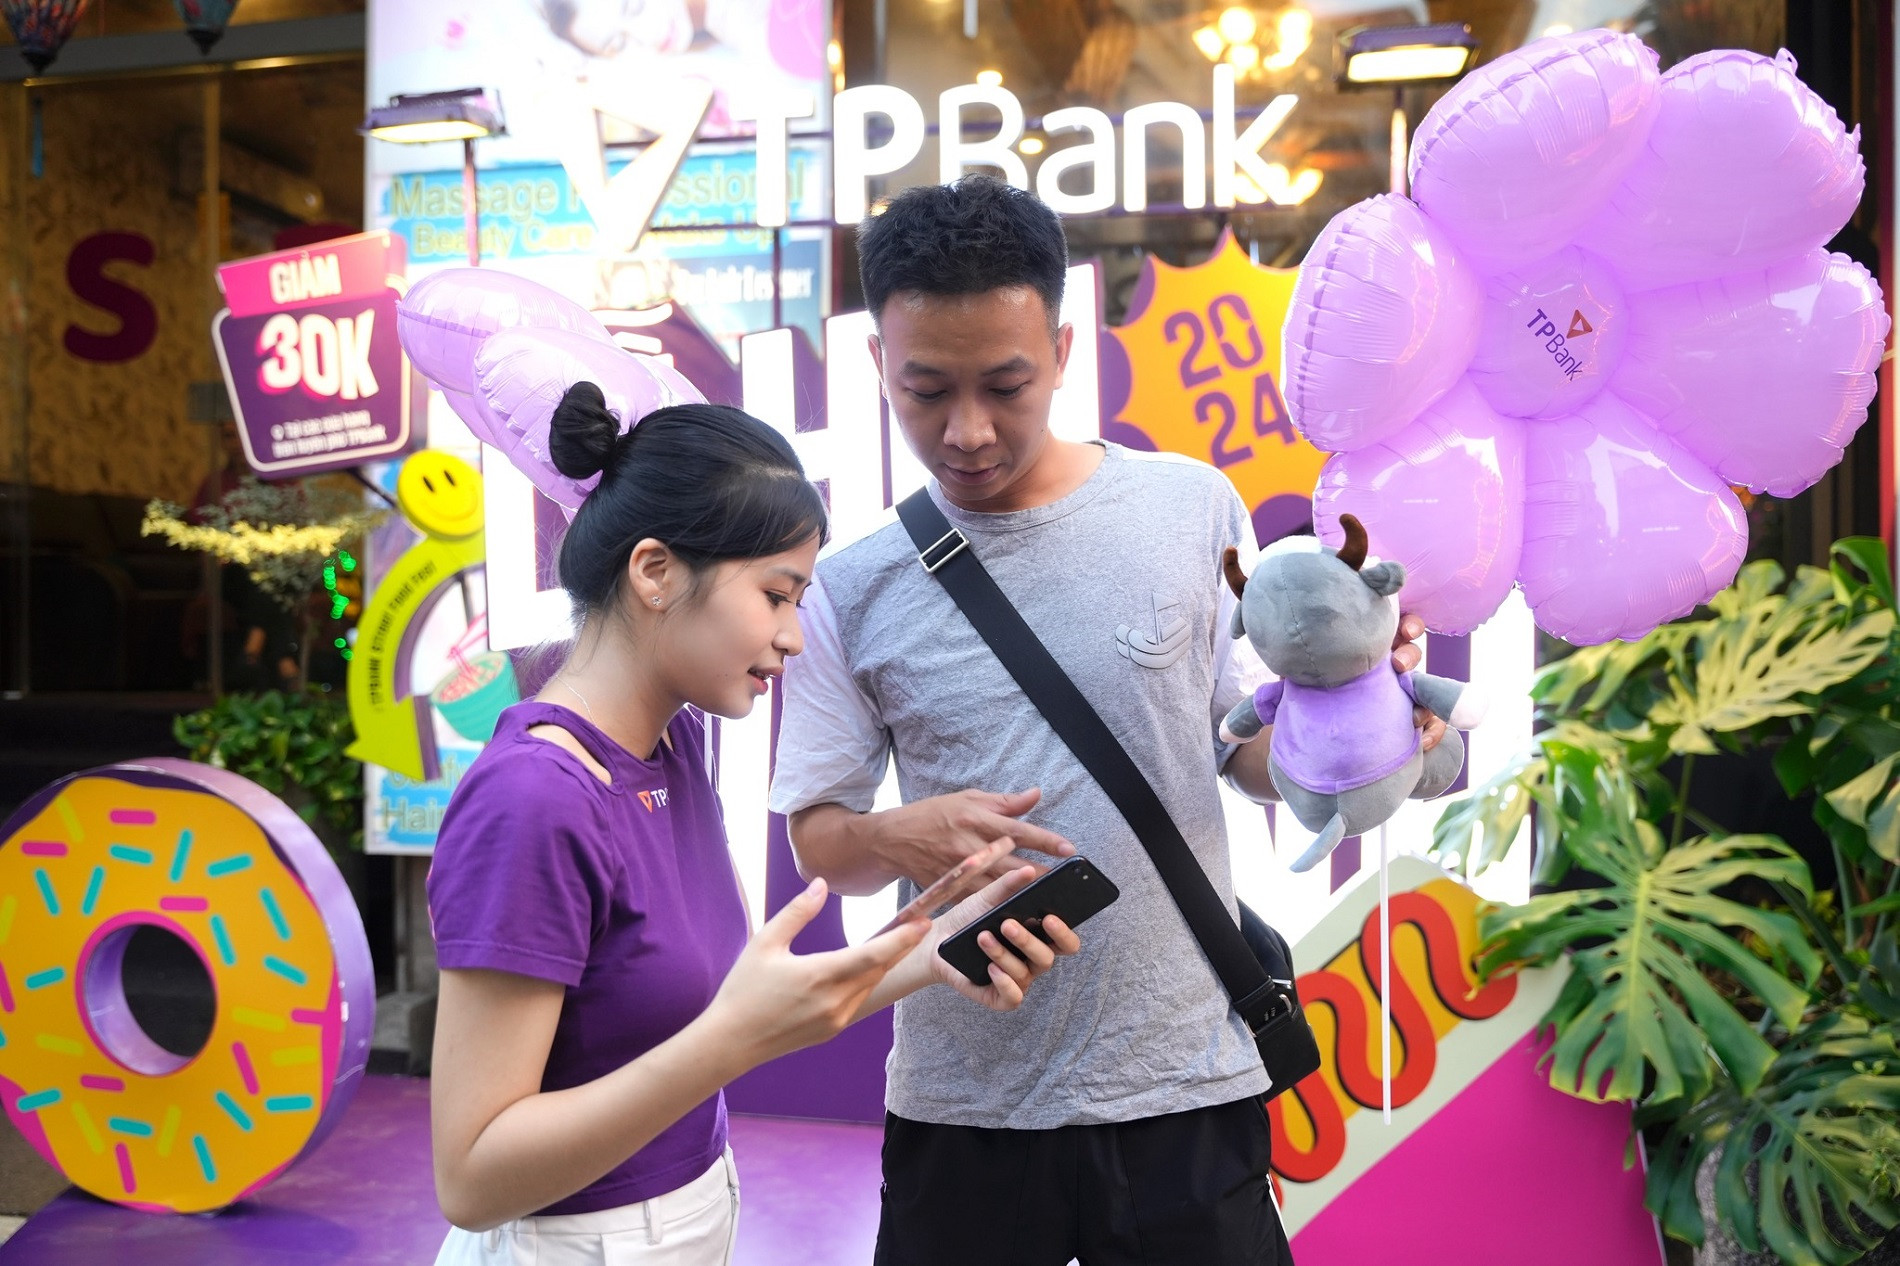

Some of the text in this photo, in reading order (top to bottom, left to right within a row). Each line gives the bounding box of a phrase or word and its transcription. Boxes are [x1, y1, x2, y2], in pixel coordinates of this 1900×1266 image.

[729, 63, 1299, 227] TPBank
[269, 250, 343, 304] GIẢM
[414, 223, 515, 257] Beaty
[257, 308, 380, 400] 30K
[1164, 294, 1264, 389] 20
[1527, 308, 1583, 381] TPBank
[1195, 372, 1297, 469] 24
[650, 787, 670, 808] TP
